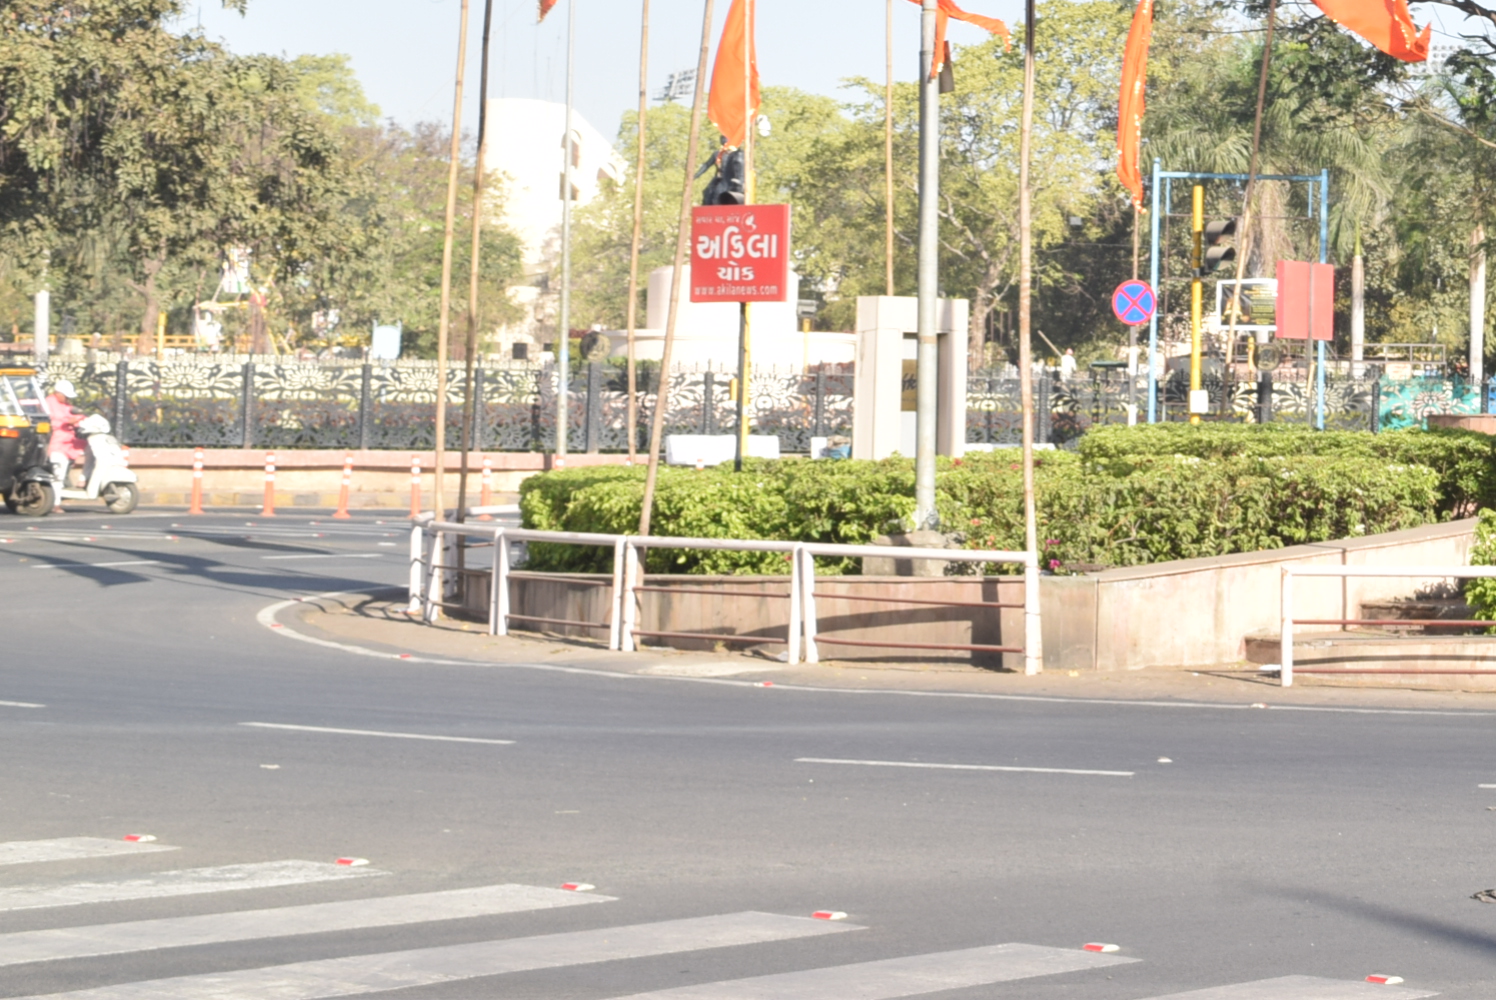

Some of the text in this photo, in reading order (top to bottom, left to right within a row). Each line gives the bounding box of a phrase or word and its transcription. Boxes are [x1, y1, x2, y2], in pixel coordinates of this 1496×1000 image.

[696, 225, 777, 259] અકિલા
[717, 260, 755, 281] ચોક
[694, 283, 778, 296] www.akilanews.com
